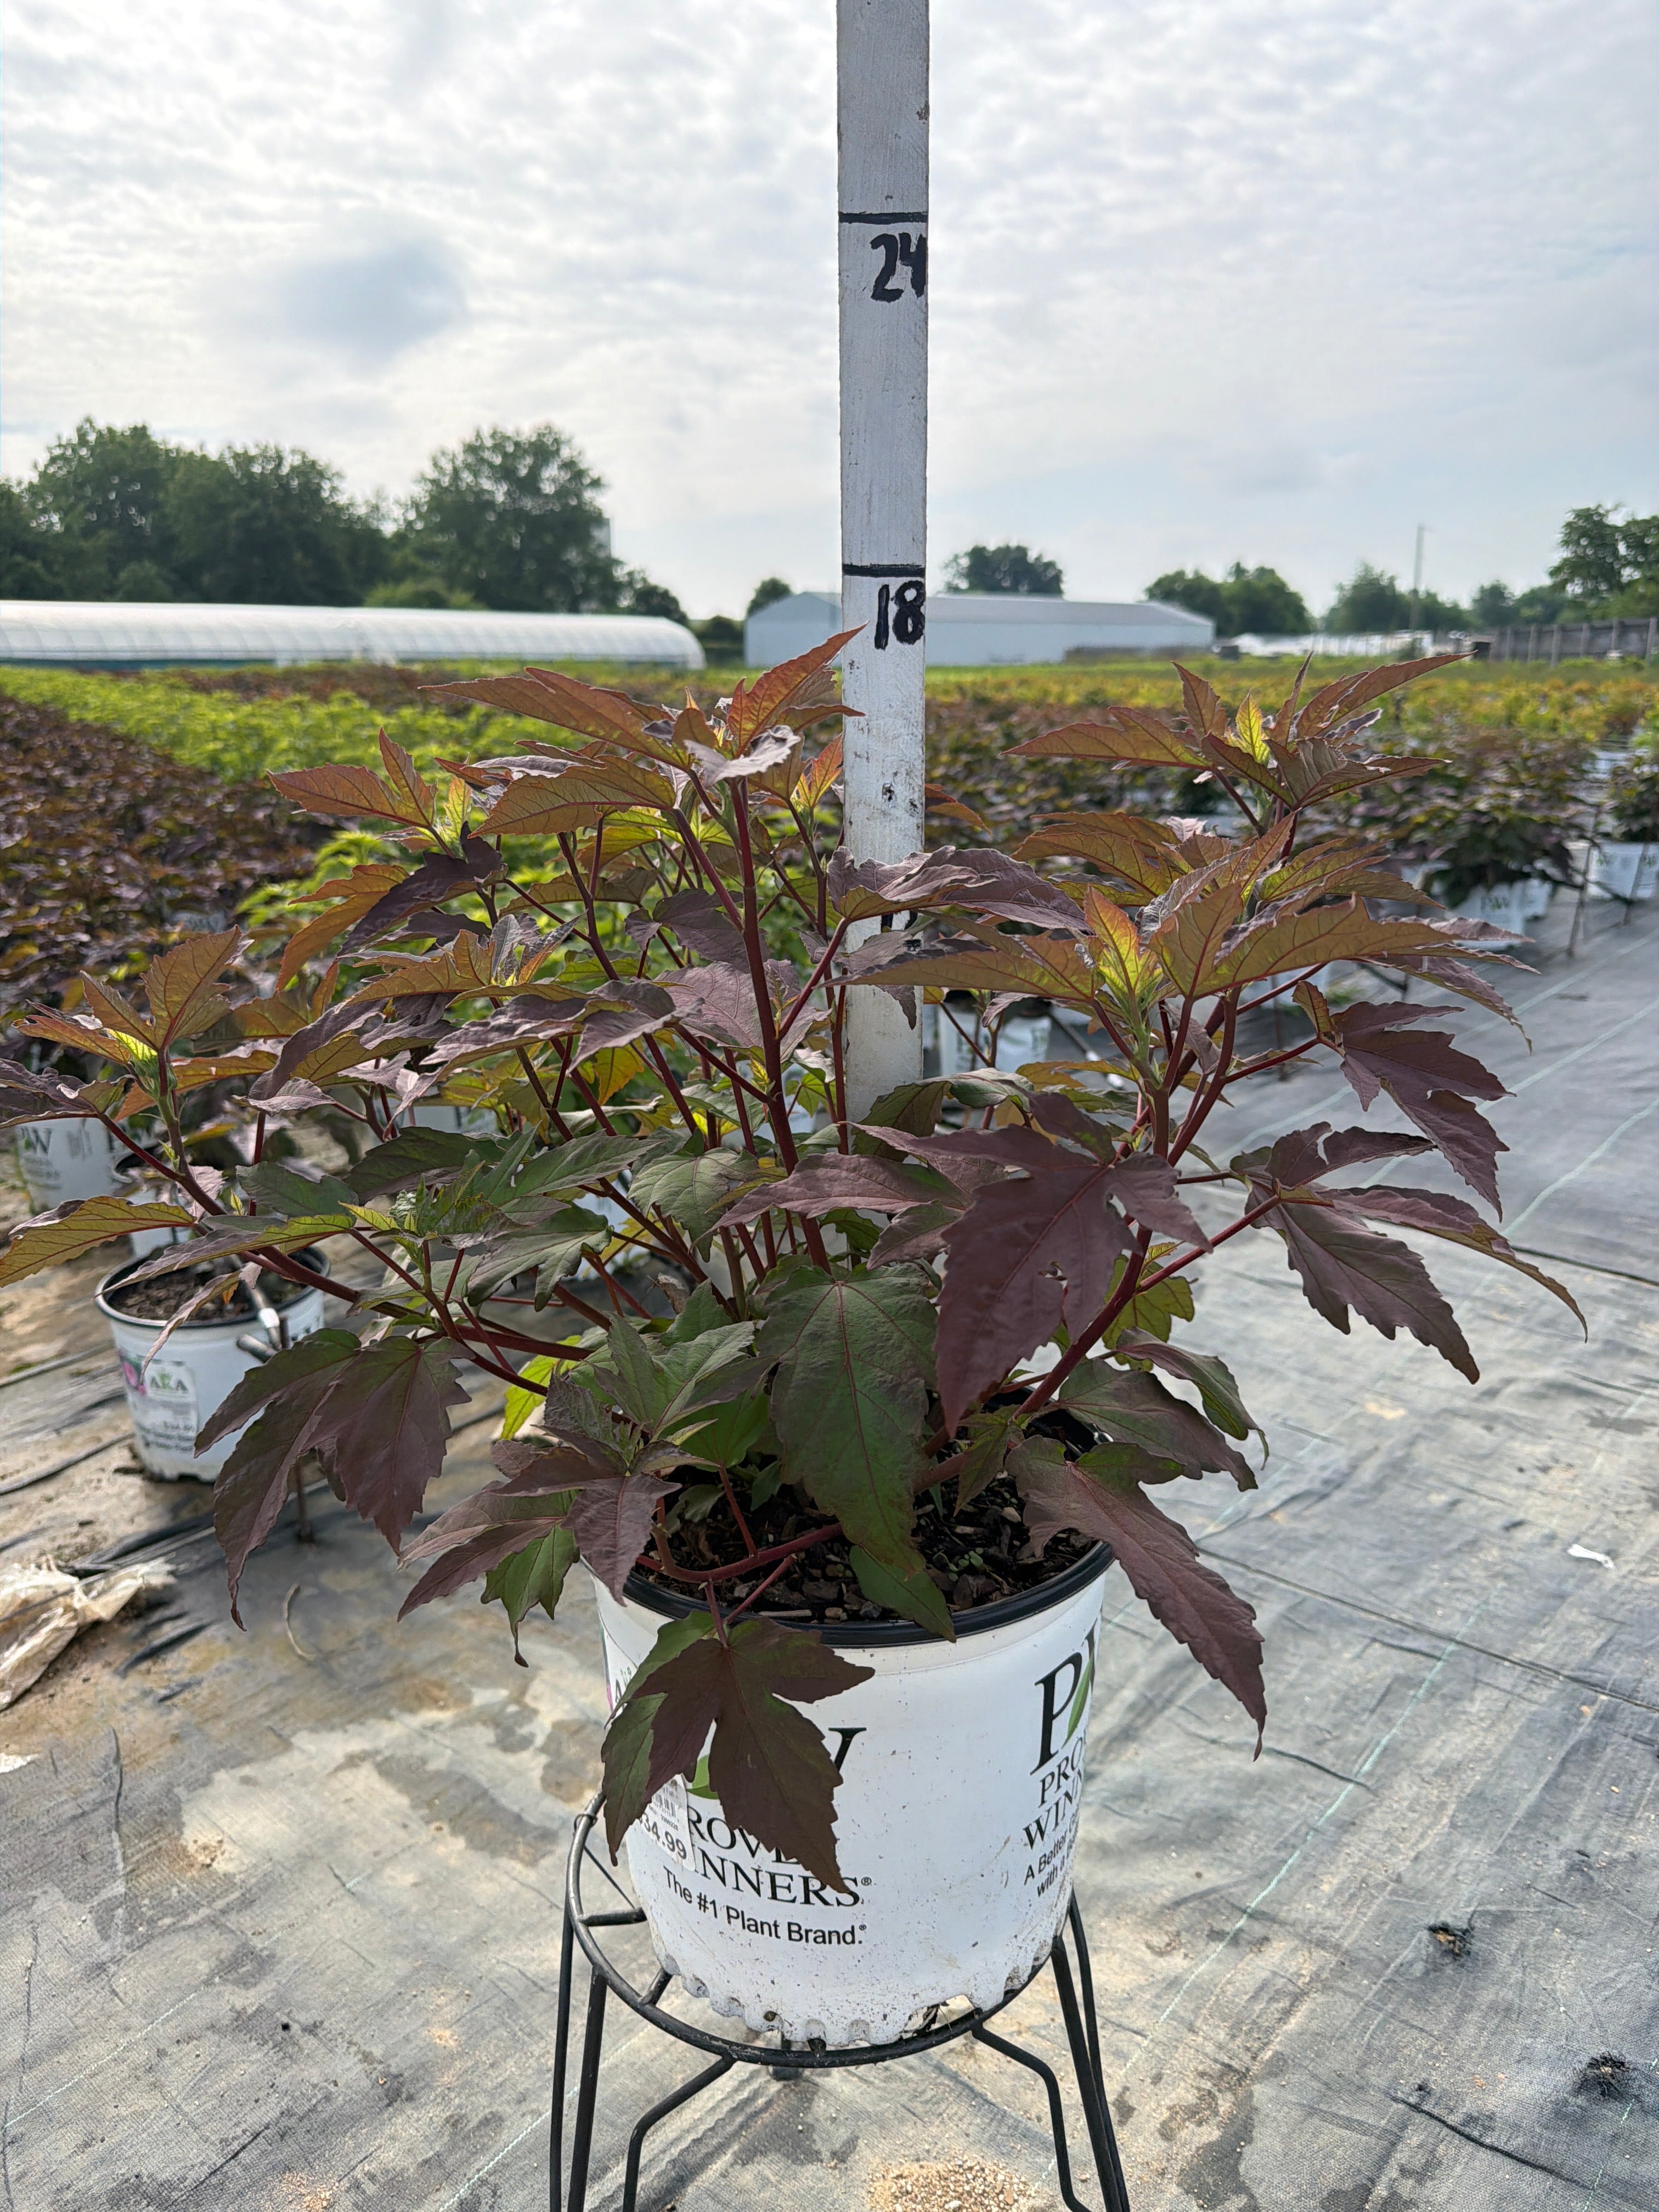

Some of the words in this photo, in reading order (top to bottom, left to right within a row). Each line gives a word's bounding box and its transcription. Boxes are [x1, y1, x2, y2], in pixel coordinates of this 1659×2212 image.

[869, 232, 927, 303] 24
[874, 579, 926, 651] 18
[1038, 1731, 1086, 1808] PRO
[687, 1804, 801, 1865] ROV
[1023, 1864, 1035, 1886] A
[1038, 1828, 1068, 1875] Better
[663, 1865, 692, 1904] The
[697, 1892, 718, 1919] #1
[726, 1905, 781, 1939] Plant
[1037, 1863, 1058, 1898] with
